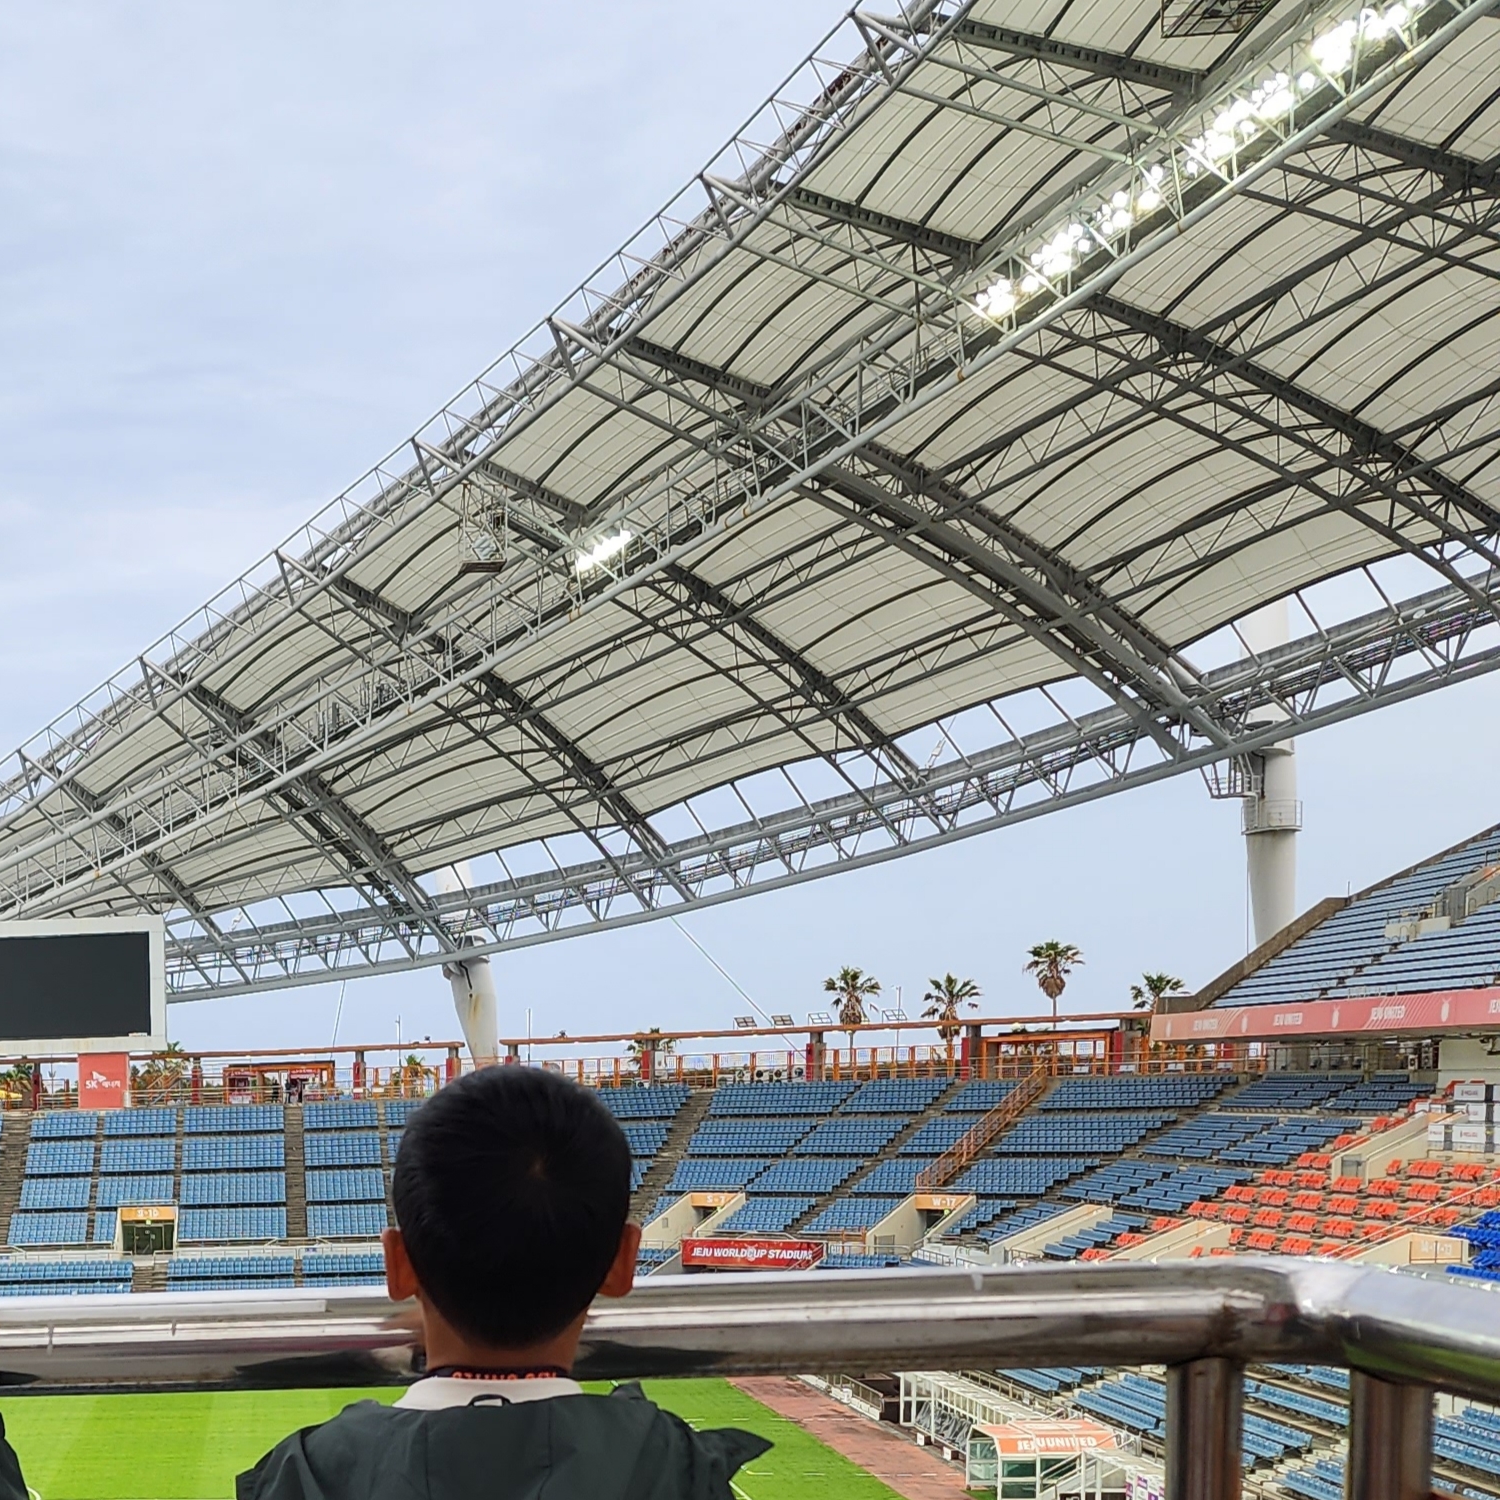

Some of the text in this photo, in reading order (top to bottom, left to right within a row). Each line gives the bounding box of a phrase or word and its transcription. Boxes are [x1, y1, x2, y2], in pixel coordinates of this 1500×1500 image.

[932, 1197, 956, 1207] W-17
[691, 1247, 712, 1257] JEJU
[768, 1249, 812, 1260] STADIUM
